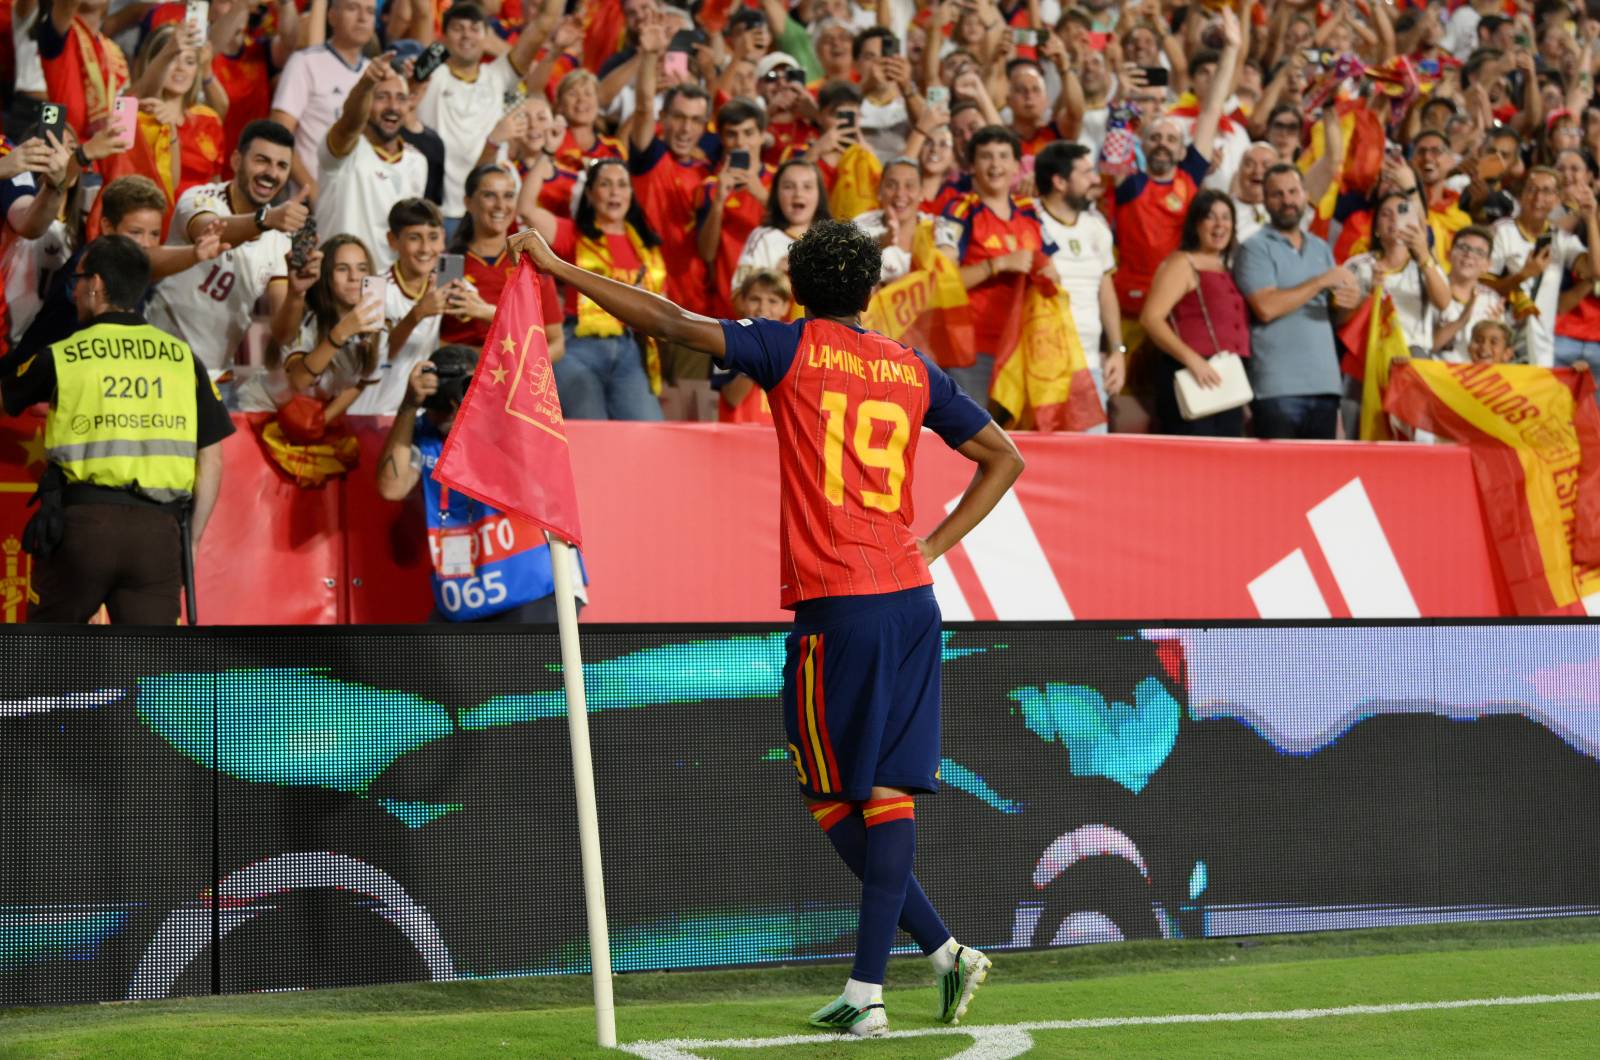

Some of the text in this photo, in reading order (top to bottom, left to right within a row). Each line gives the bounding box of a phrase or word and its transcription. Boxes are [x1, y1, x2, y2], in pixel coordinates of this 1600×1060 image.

[198, 263, 235, 302] 19
[64, 338, 185, 363] SEGURIDAD
[808, 343, 924, 388] LAMINE YAMAL
[103, 375, 164, 399] 2201
[1446, 361, 1541, 424] AMOS
[94, 413, 187, 430] PROSEGUR
[821, 390, 911, 513] 19
[441, 570, 508, 612] 065
